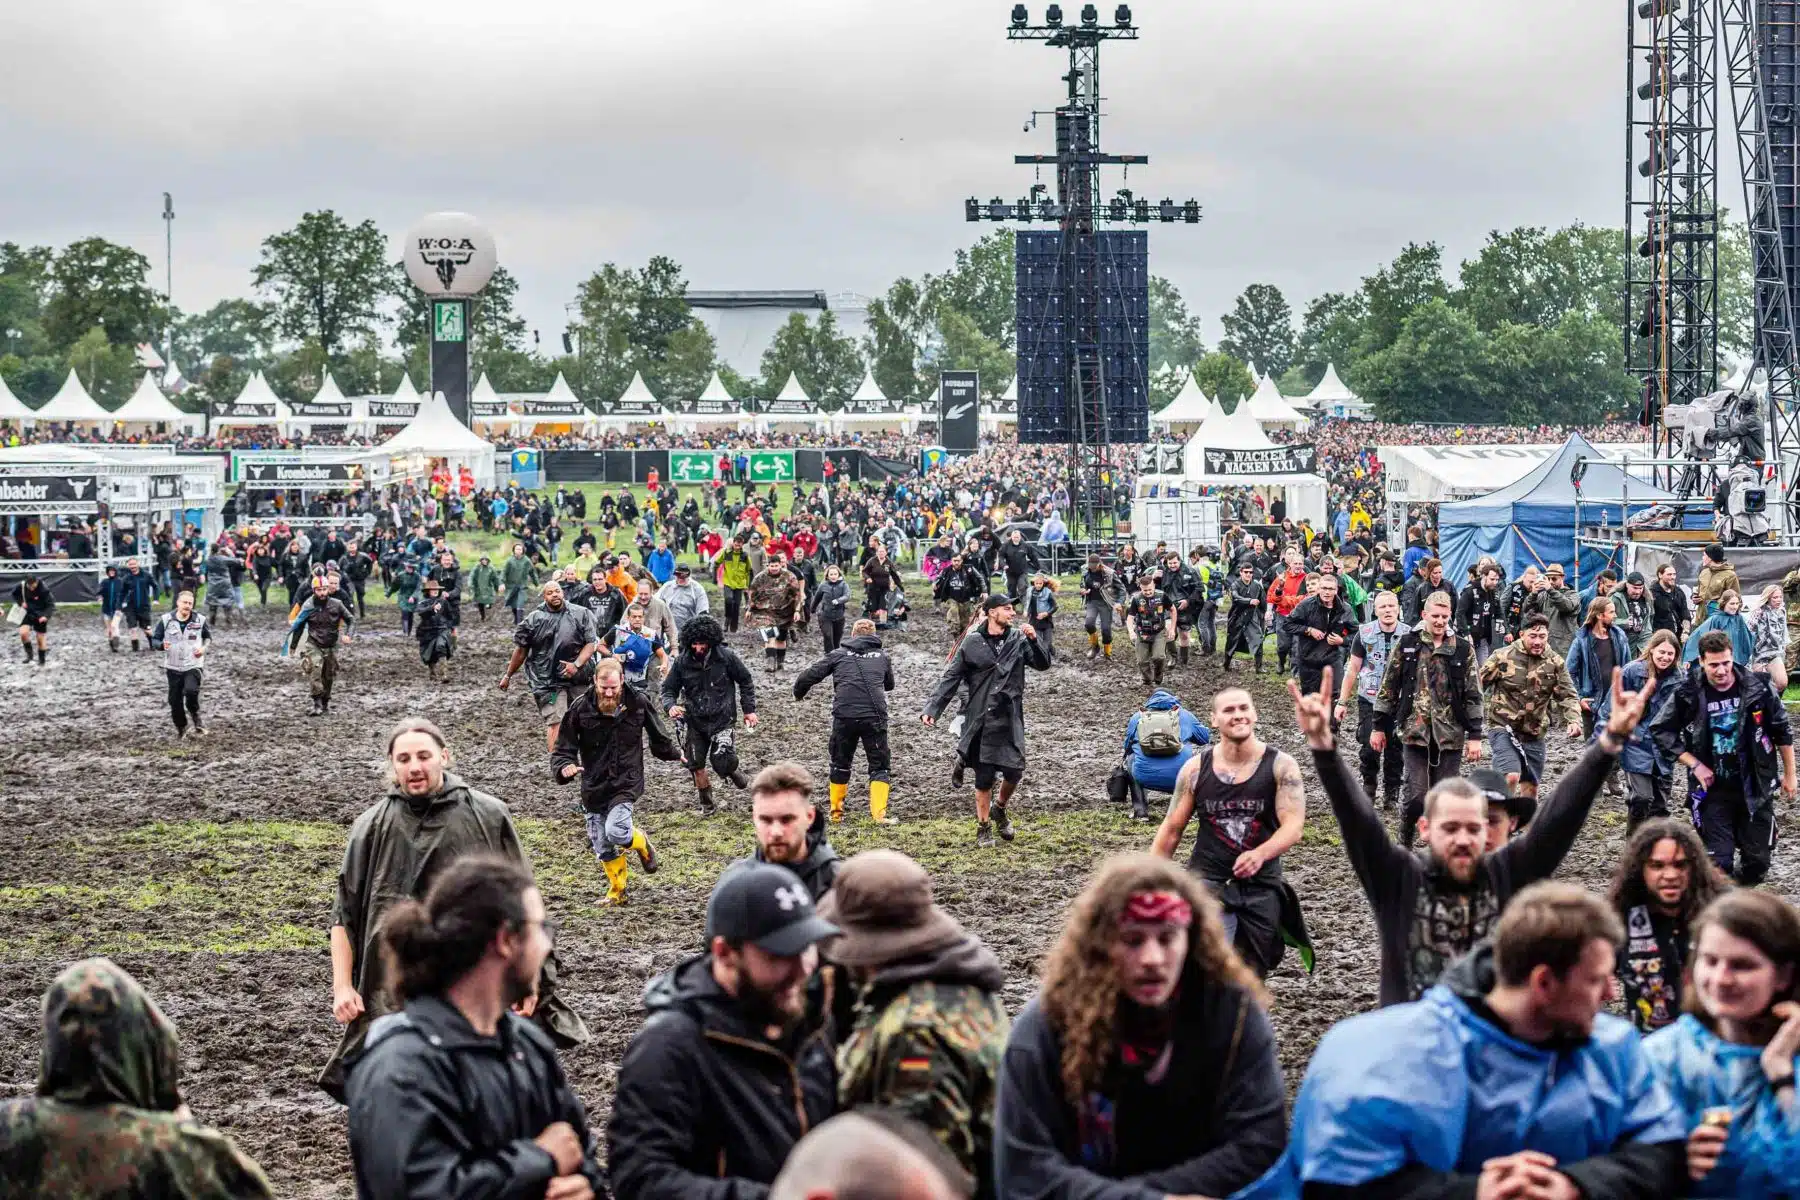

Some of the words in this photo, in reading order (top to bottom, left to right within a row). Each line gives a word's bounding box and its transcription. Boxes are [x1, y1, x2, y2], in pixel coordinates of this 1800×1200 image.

[418, 238, 476, 250] W:O:A
[1232, 450, 1287, 461] WACKEN
[1225, 461, 1270, 474] NACKEN
[1272, 459, 1297, 472] XXL
